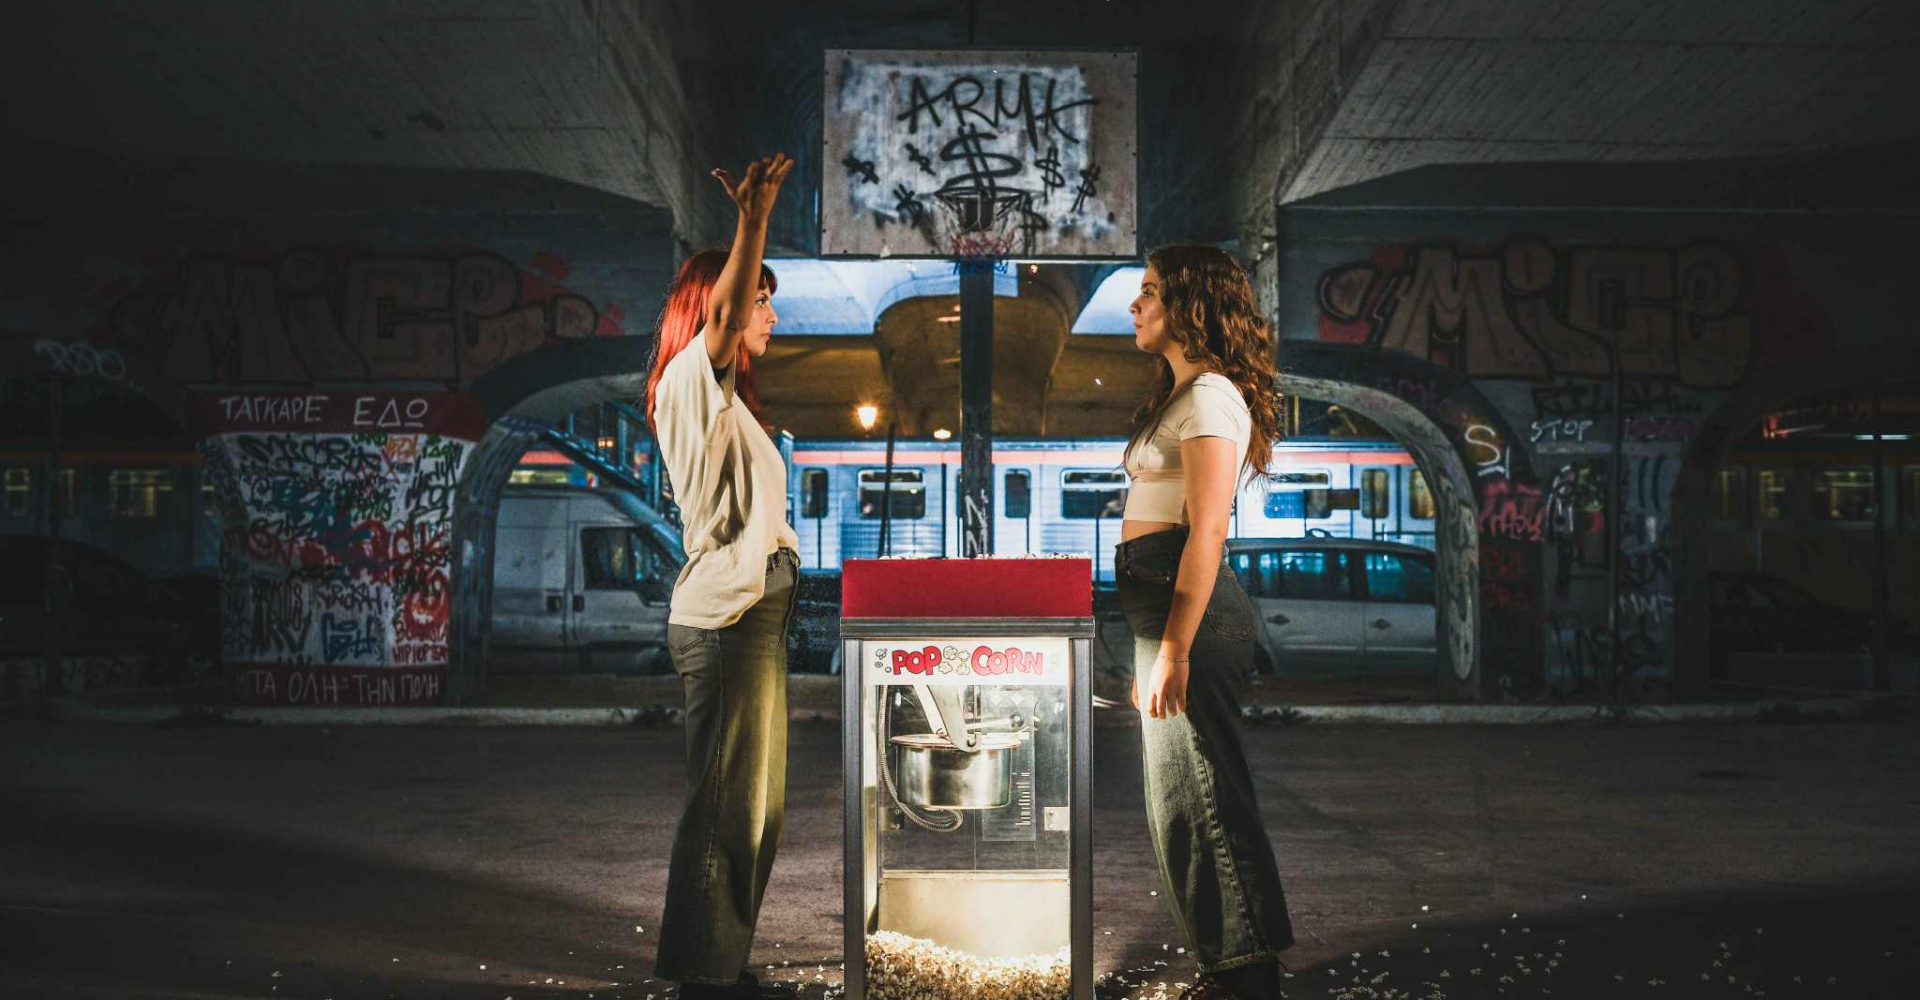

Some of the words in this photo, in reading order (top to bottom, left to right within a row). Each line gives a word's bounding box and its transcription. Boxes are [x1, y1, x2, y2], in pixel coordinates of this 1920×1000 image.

[353, 396, 429, 428] ΕΔΩ
[1530, 419, 1594, 442] STOP
[892, 645, 942, 676] POP
[970, 645, 1044, 676] CORN
[352, 673, 396, 705] ΤΗΝ
